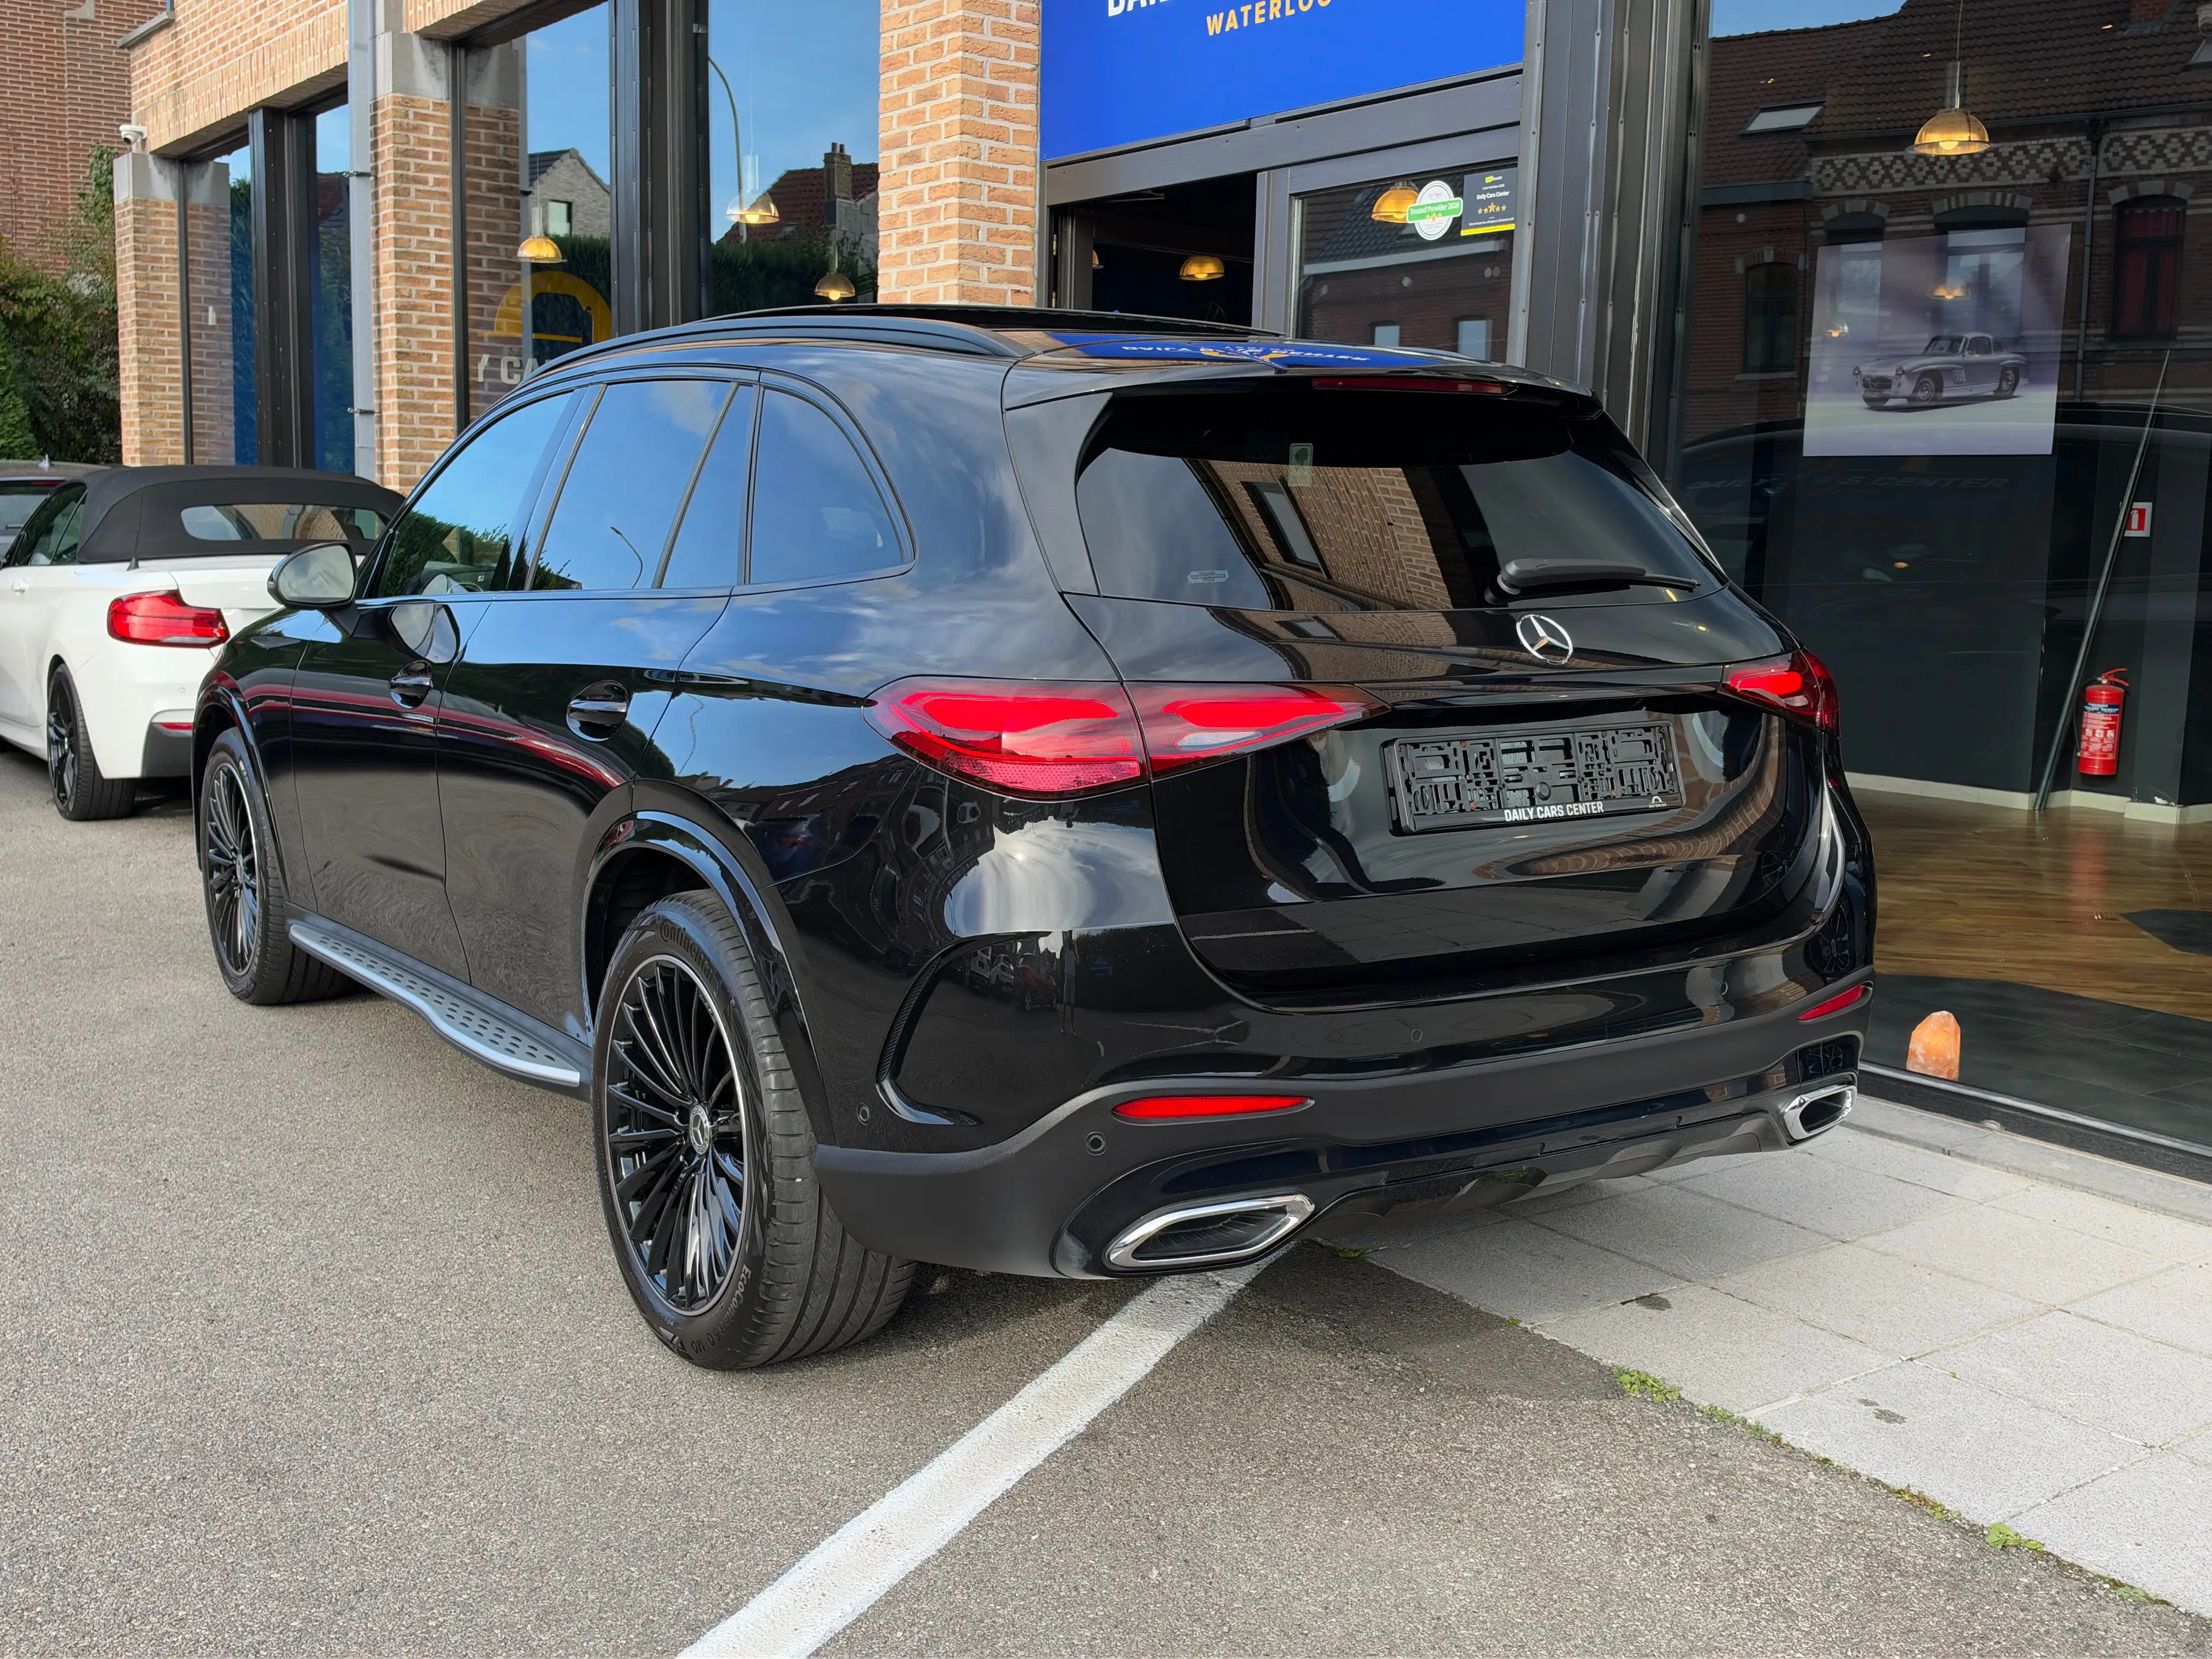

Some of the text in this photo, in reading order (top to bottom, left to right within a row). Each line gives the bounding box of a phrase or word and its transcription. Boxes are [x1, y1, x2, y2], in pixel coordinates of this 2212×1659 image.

[1410, 206, 1427, 214] Trusted
[1427, 203, 1448, 212] Provider
[1504, 801, 1604, 822] DAILY CARS CENTER
[717, 1263, 752, 1336] EcoContact
[691, 1338, 706, 1354] MO
